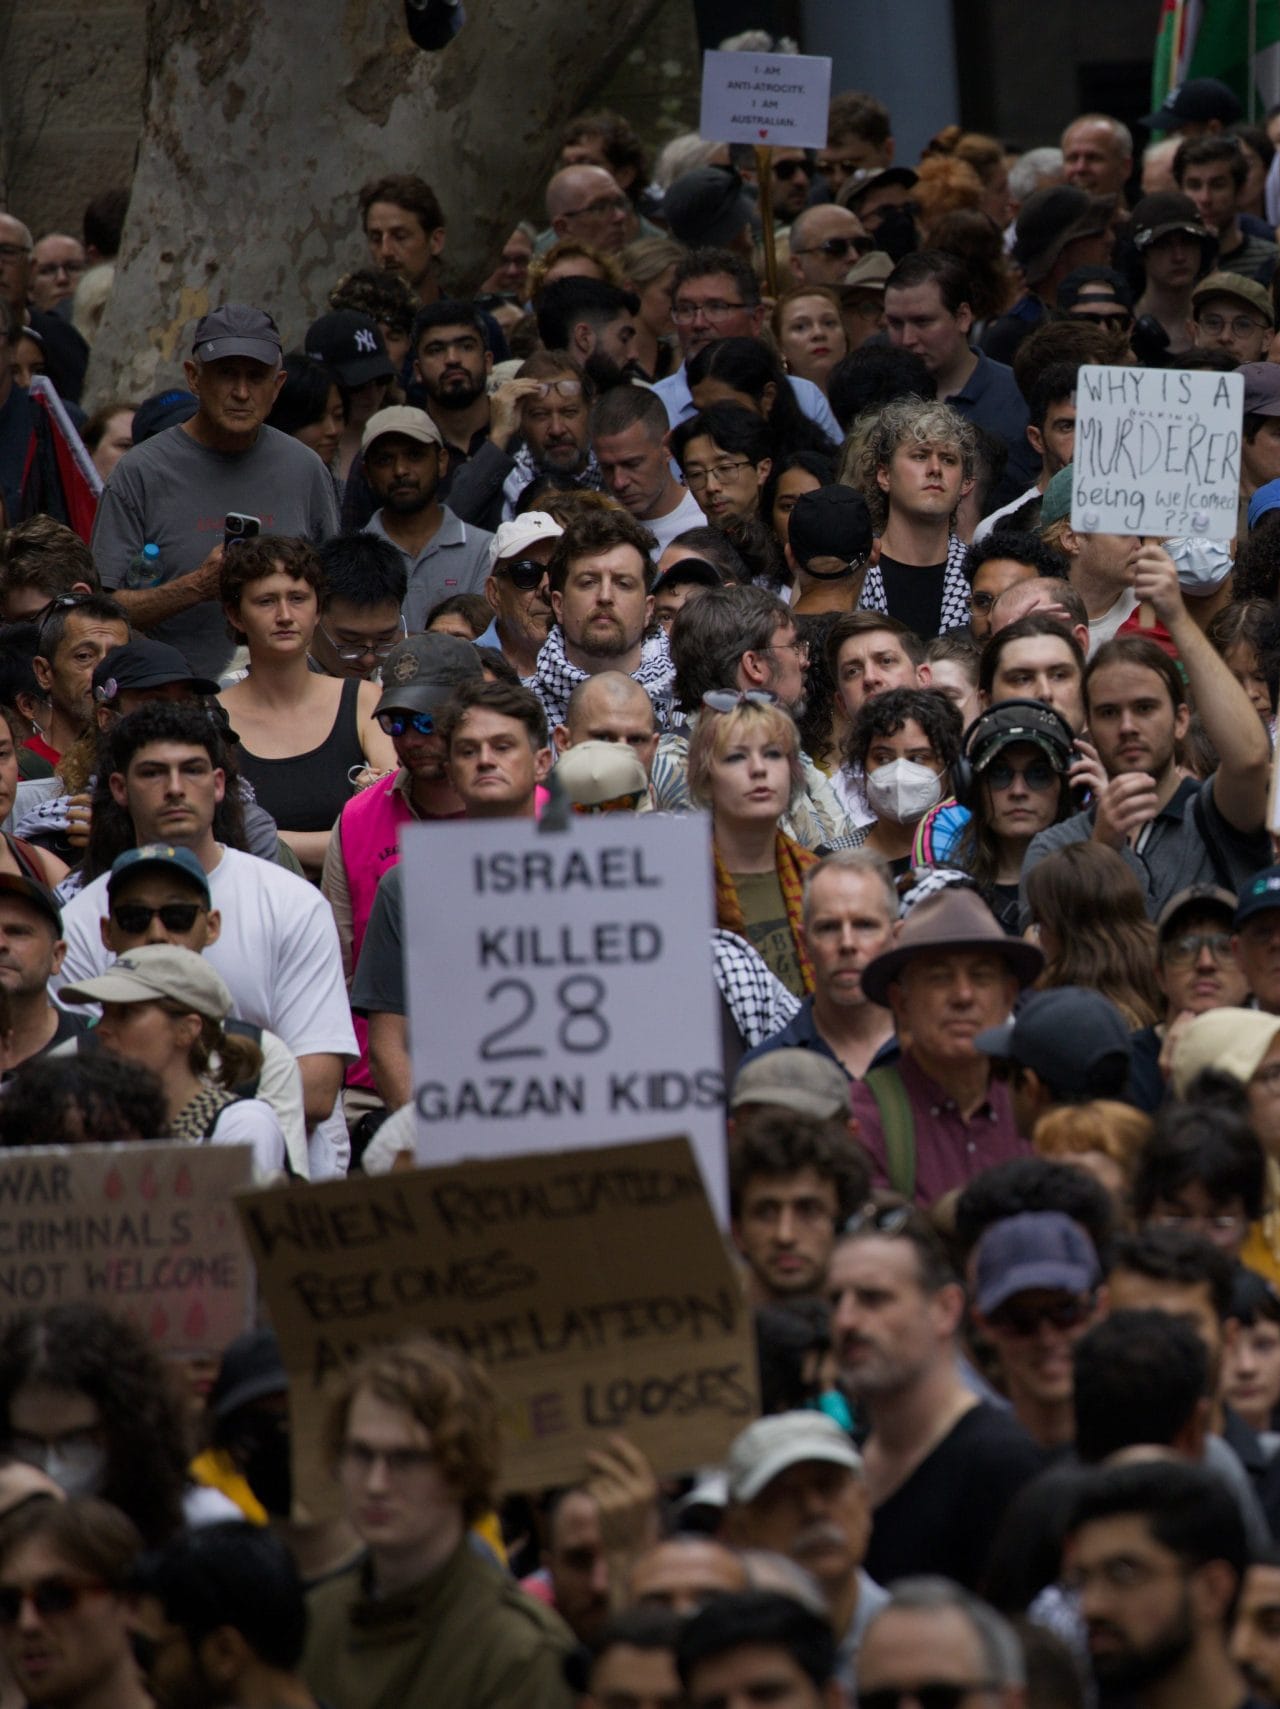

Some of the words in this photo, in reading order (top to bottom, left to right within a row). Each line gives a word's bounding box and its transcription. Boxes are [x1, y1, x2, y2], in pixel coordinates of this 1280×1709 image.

[763, 66, 782, 76] AM
[761, 100, 779, 109] AM
[1084, 370, 1144, 405] WHY
[1162, 372, 1192, 404] IS
[1213, 376, 1230, 409] A
[1078, 417, 1240, 486] MURDERER
[1076, 477, 1146, 530] being
[472, 847, 663, 895] ISRAEL
[479, 921, 663, 969] KILLED
[479, 973, 611, 1063] 28
[416, 1075, 585, 1122] GAZAN
[609, 1069, 728, 1114] KIDS
[0, 1165, 72, 1202] WAR
[246, 1192, 417, 1259] WHEN
[83, 1252, 237, 1294] WELCOME
[290, 1249, 541, 1322] BECOMES
[583, 1365, 753, 1429] LOOSES
